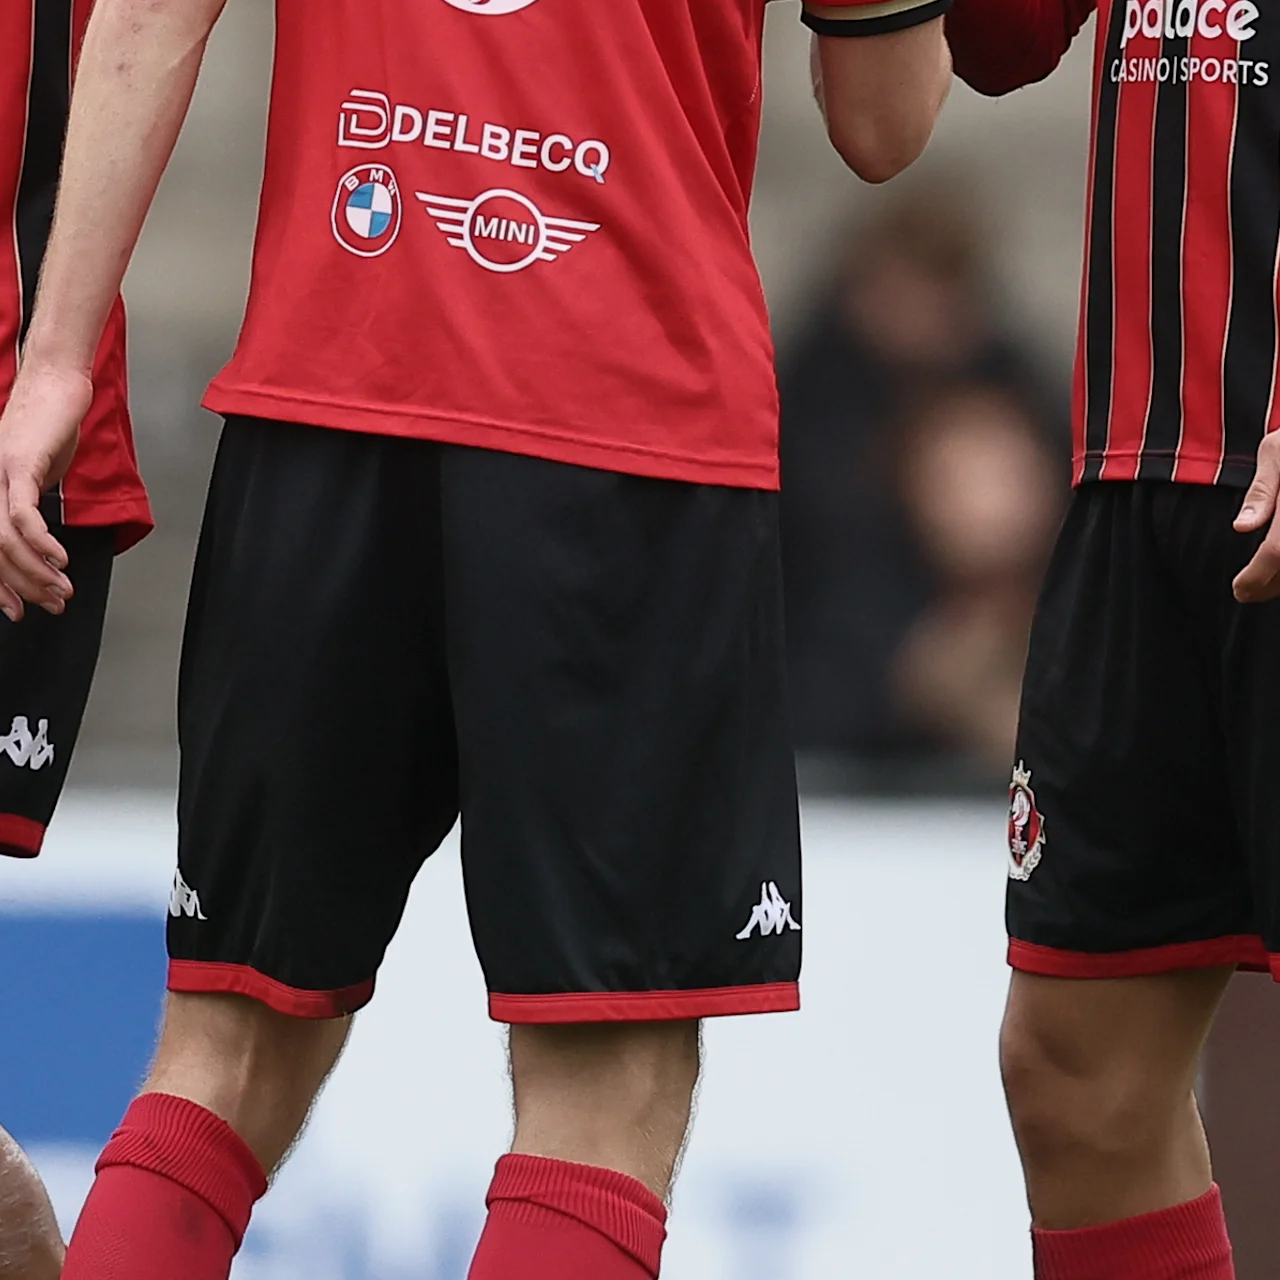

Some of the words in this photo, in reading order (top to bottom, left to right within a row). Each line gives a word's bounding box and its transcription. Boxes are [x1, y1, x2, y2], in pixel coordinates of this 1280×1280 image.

[1110, 57, 1170, 83] CASINO
[1180, 57, 1269, 86] SPORTS
[390, 104, 611, 184] DELBECQ
[344, 168, 397, 197] BMW
[473, 215, 536, 245] MINI
